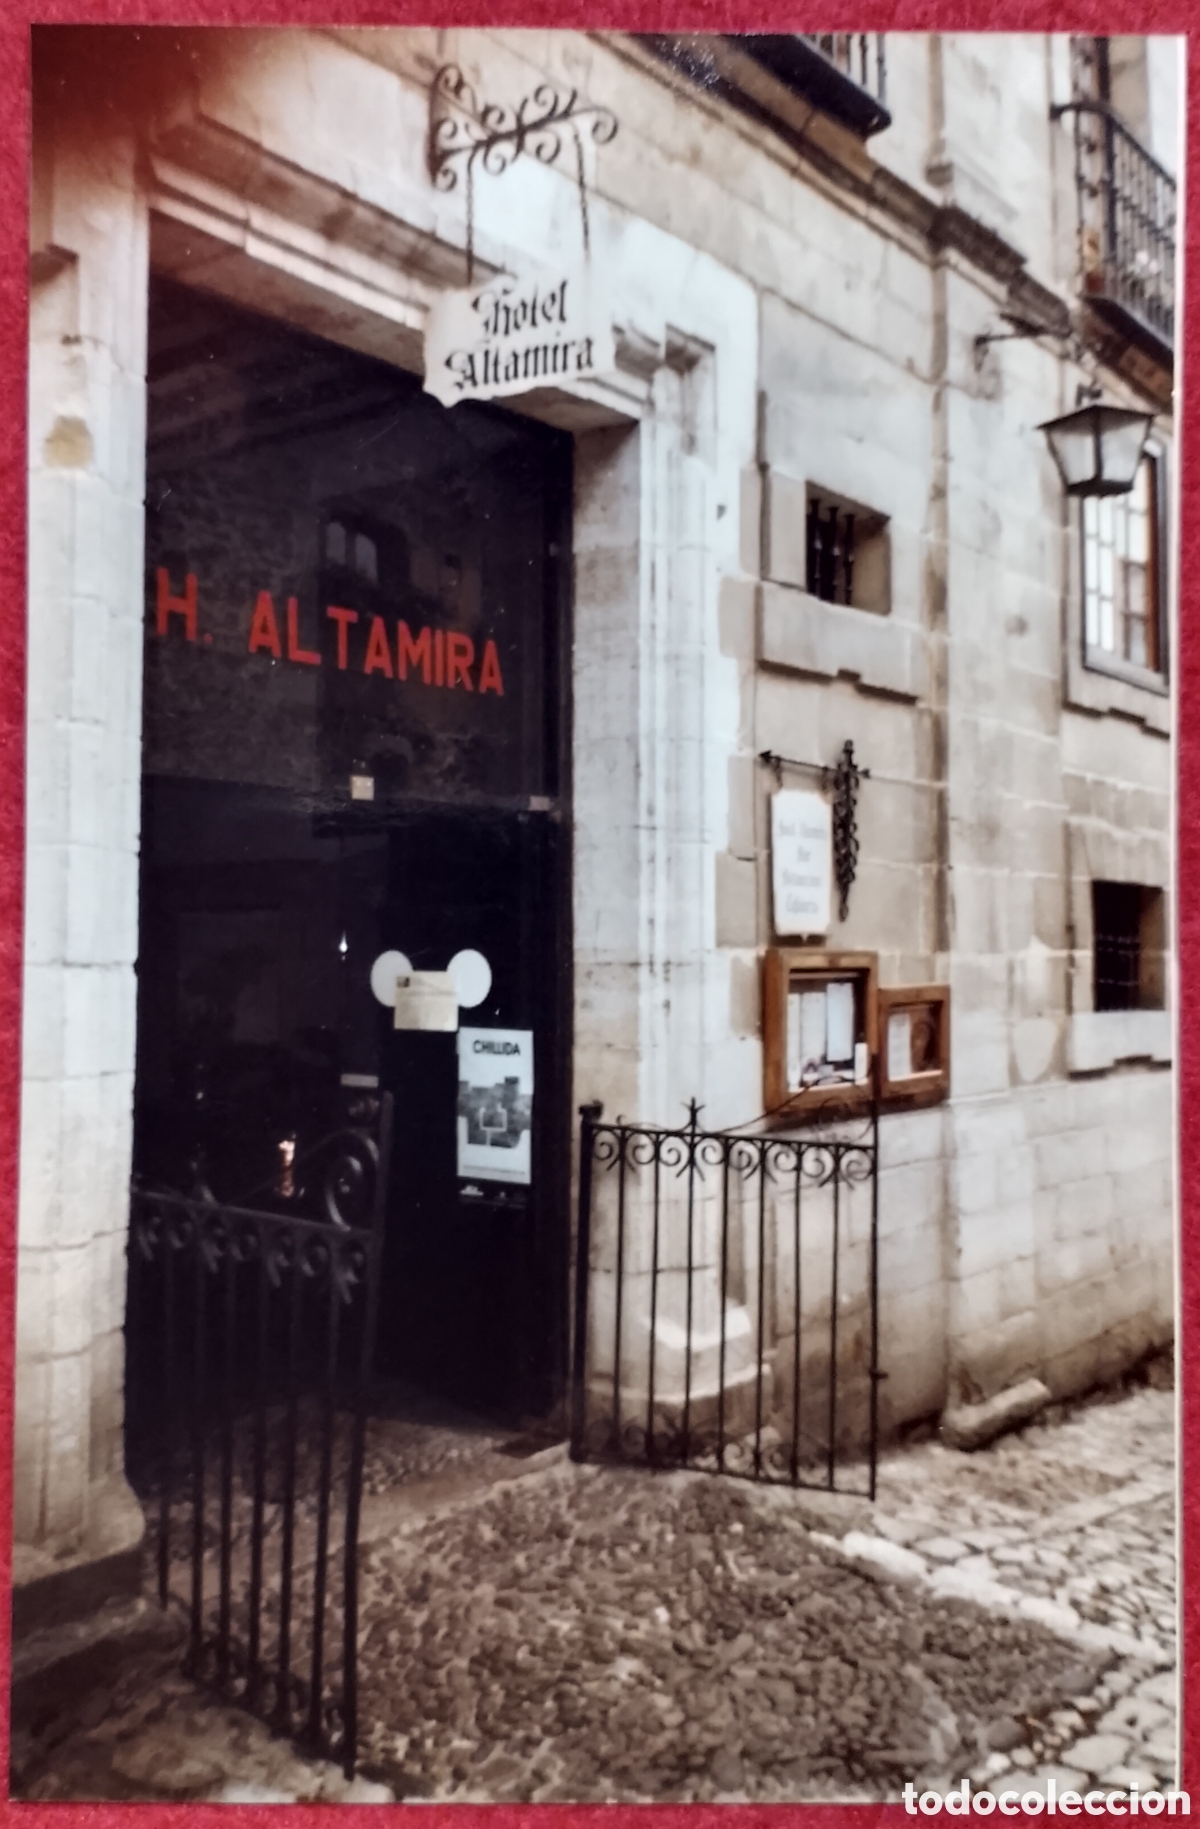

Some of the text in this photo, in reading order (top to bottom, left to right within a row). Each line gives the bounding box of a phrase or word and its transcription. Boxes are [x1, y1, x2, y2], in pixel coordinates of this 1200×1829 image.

[445, 330, 594, 390] Altamira
[156, 567, 504, 696] H. ALTAMIRA
[473, 1039, 521, 1056] CHILLIDA
